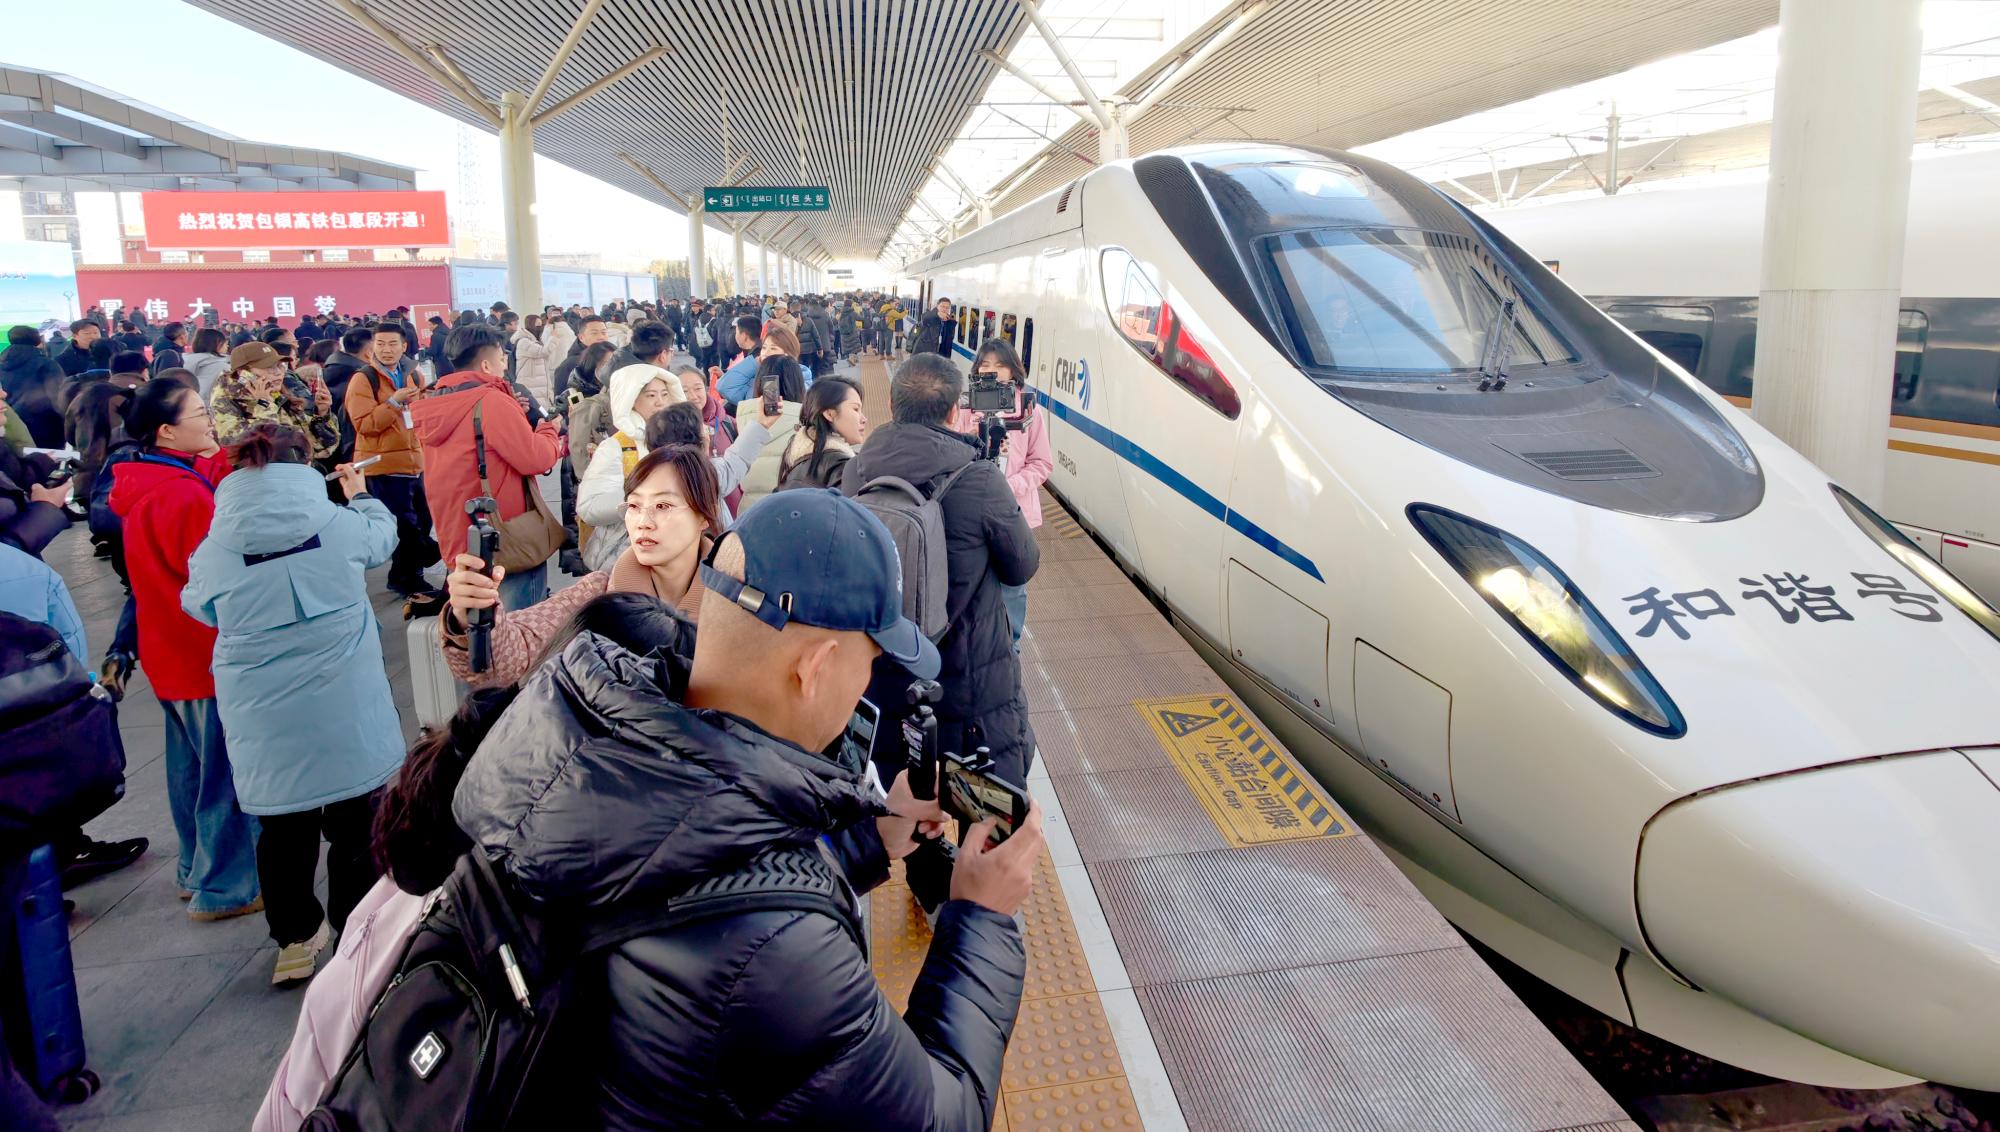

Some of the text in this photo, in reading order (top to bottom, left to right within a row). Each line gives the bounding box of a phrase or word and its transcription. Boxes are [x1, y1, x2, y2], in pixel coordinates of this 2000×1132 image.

[791, 194, 824, 203] 包头站
[1055, 357, 1077, 395] CRH
[1621, 571, 1943, 640] 和谐号
[1204, 734, 1301, 829] 小心站台间隙
[1222, 790, 1242, 810] Gap
